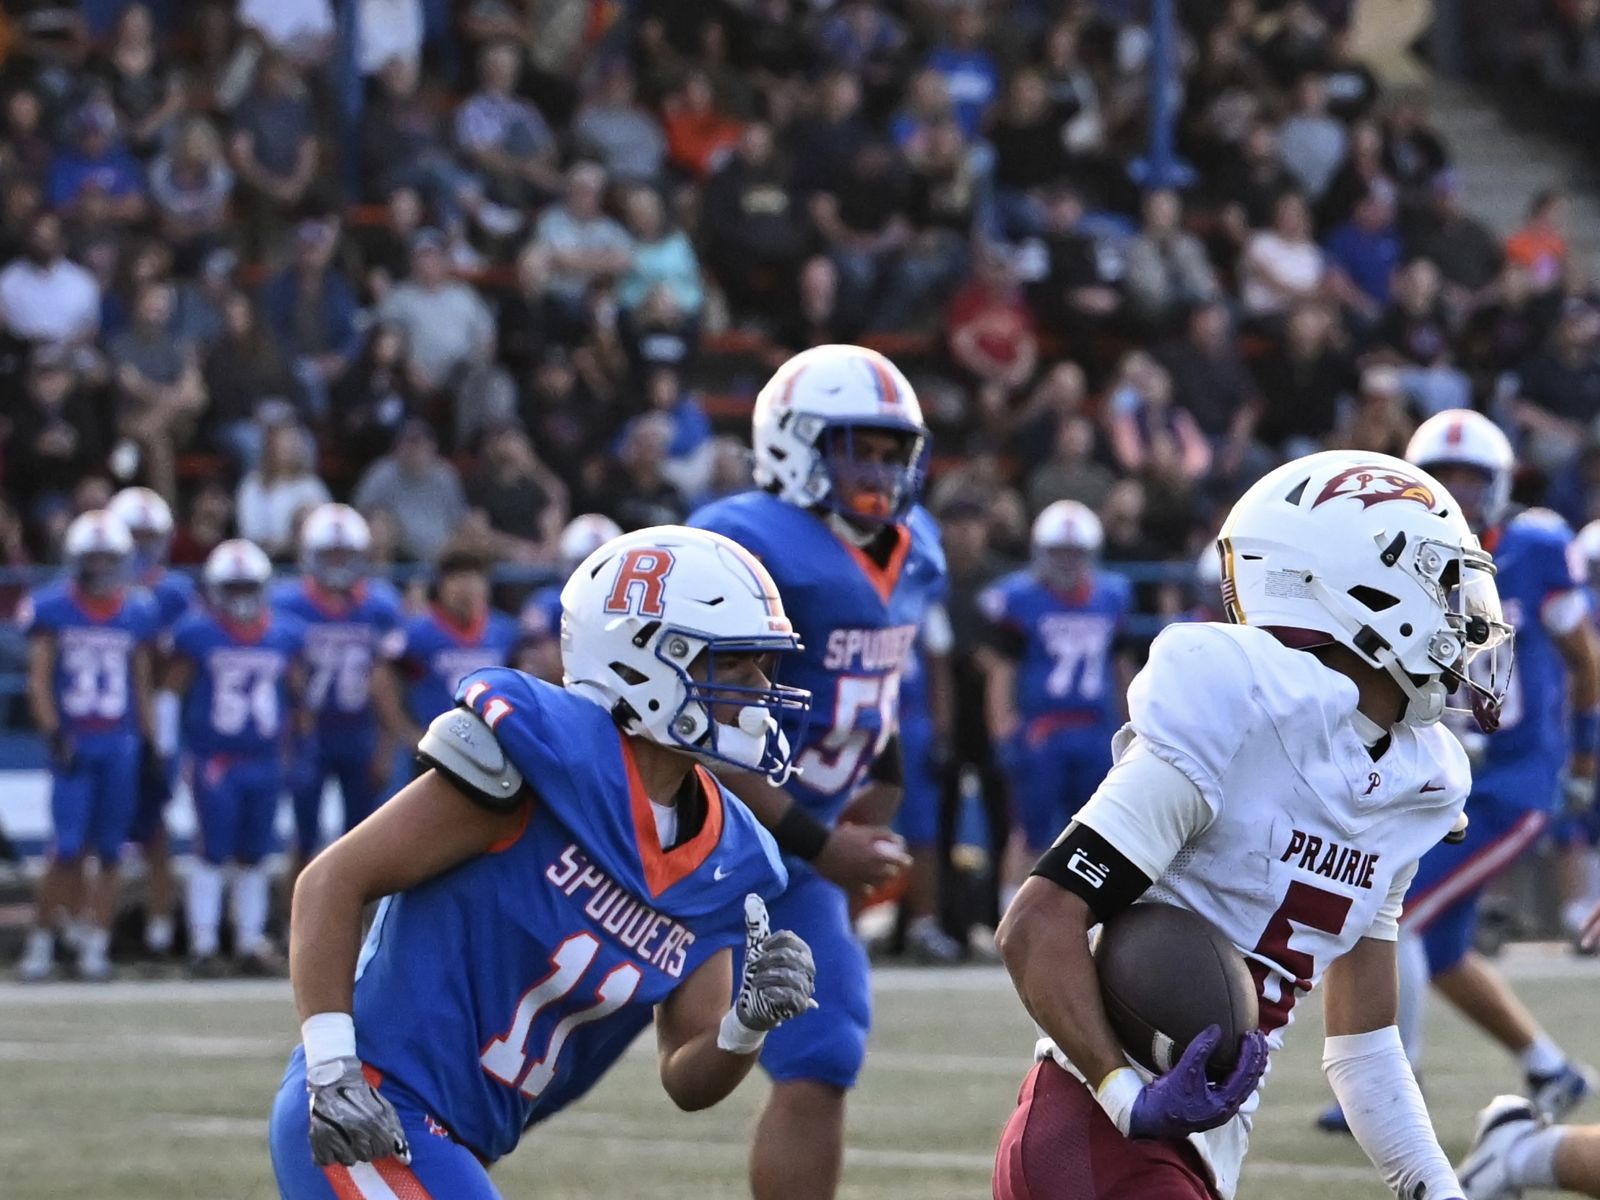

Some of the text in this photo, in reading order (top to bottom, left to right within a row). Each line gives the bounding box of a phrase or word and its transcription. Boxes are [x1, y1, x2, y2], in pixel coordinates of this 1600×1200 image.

[603, 547, 676, 619] R
[1362, 771, 1381, 796] P
[1280, 828, 1380, 890] PRAIRIE
[1245, 879, 1355, 1037] 5
[479, 929, 643, 1100] 11
